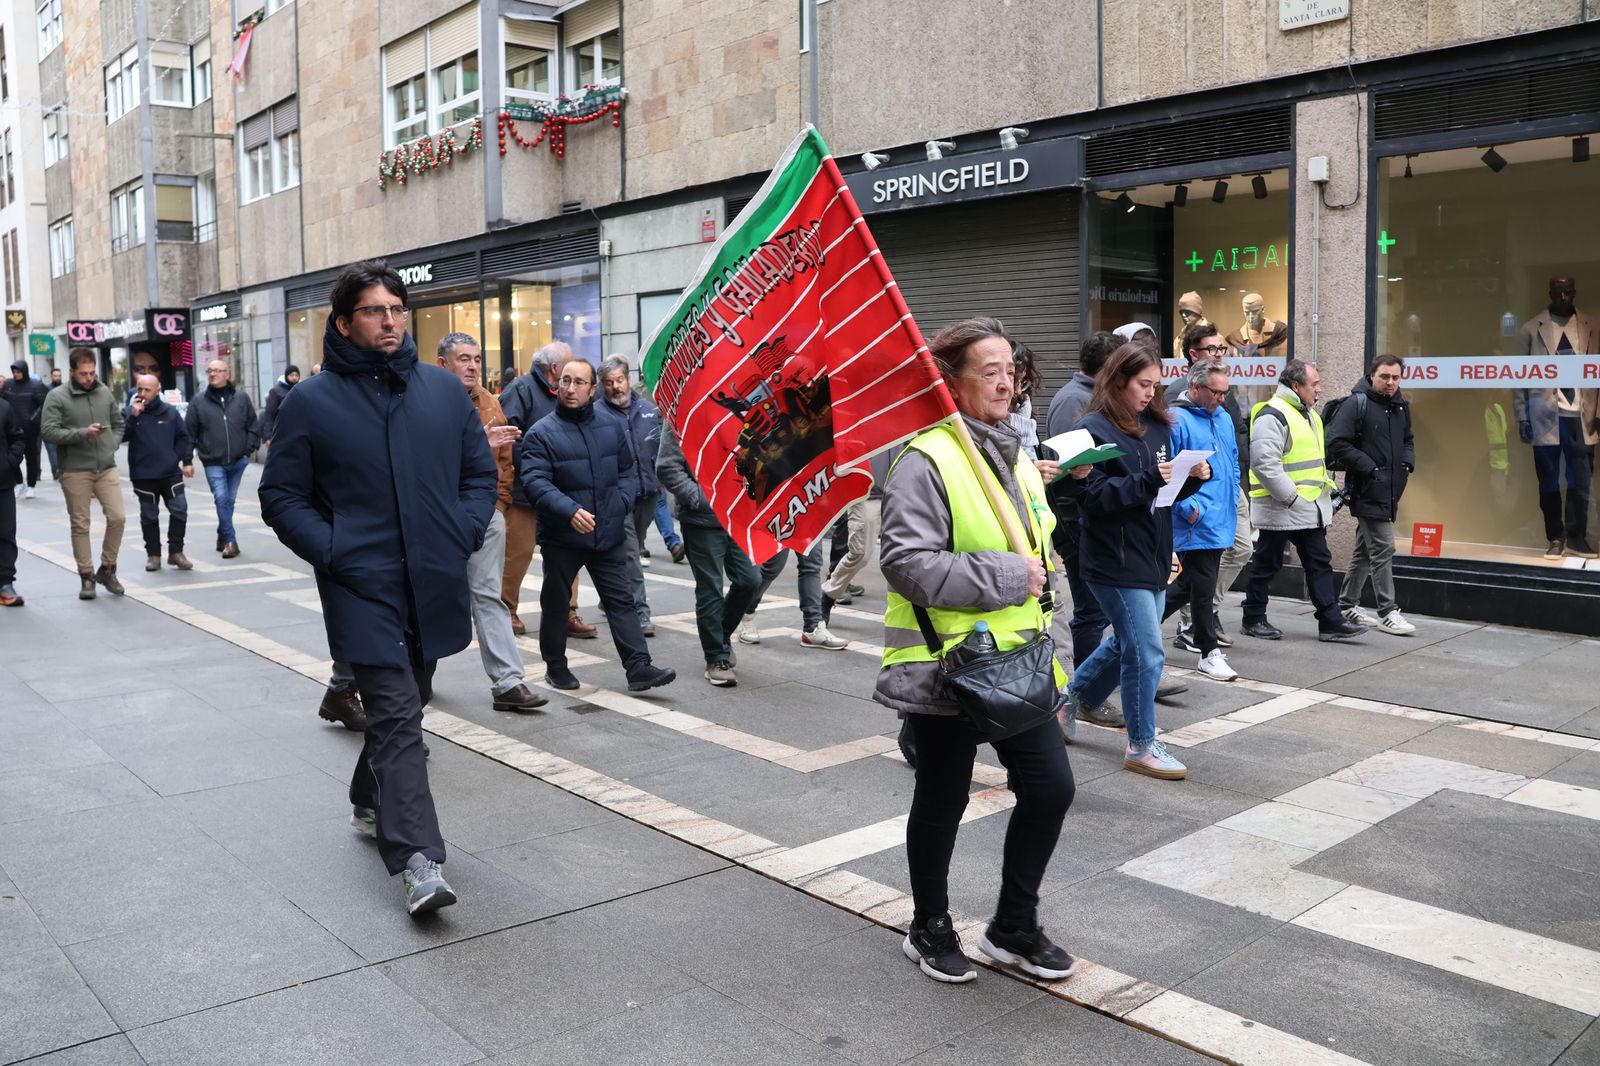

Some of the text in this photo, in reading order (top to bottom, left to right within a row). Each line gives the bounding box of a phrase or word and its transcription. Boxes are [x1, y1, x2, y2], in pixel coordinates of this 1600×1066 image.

[1283, 6, 1343, 25] SANTA CLARA
[1306, 2, 1319, 11] DE
[872, 158, 1030, 204] SPRINGFIELD
[713, 219, 827, 320] GANADERO
[1459, 363, 1558, 380] REBAJAS
[767, 464, 833, 542] ZAM
